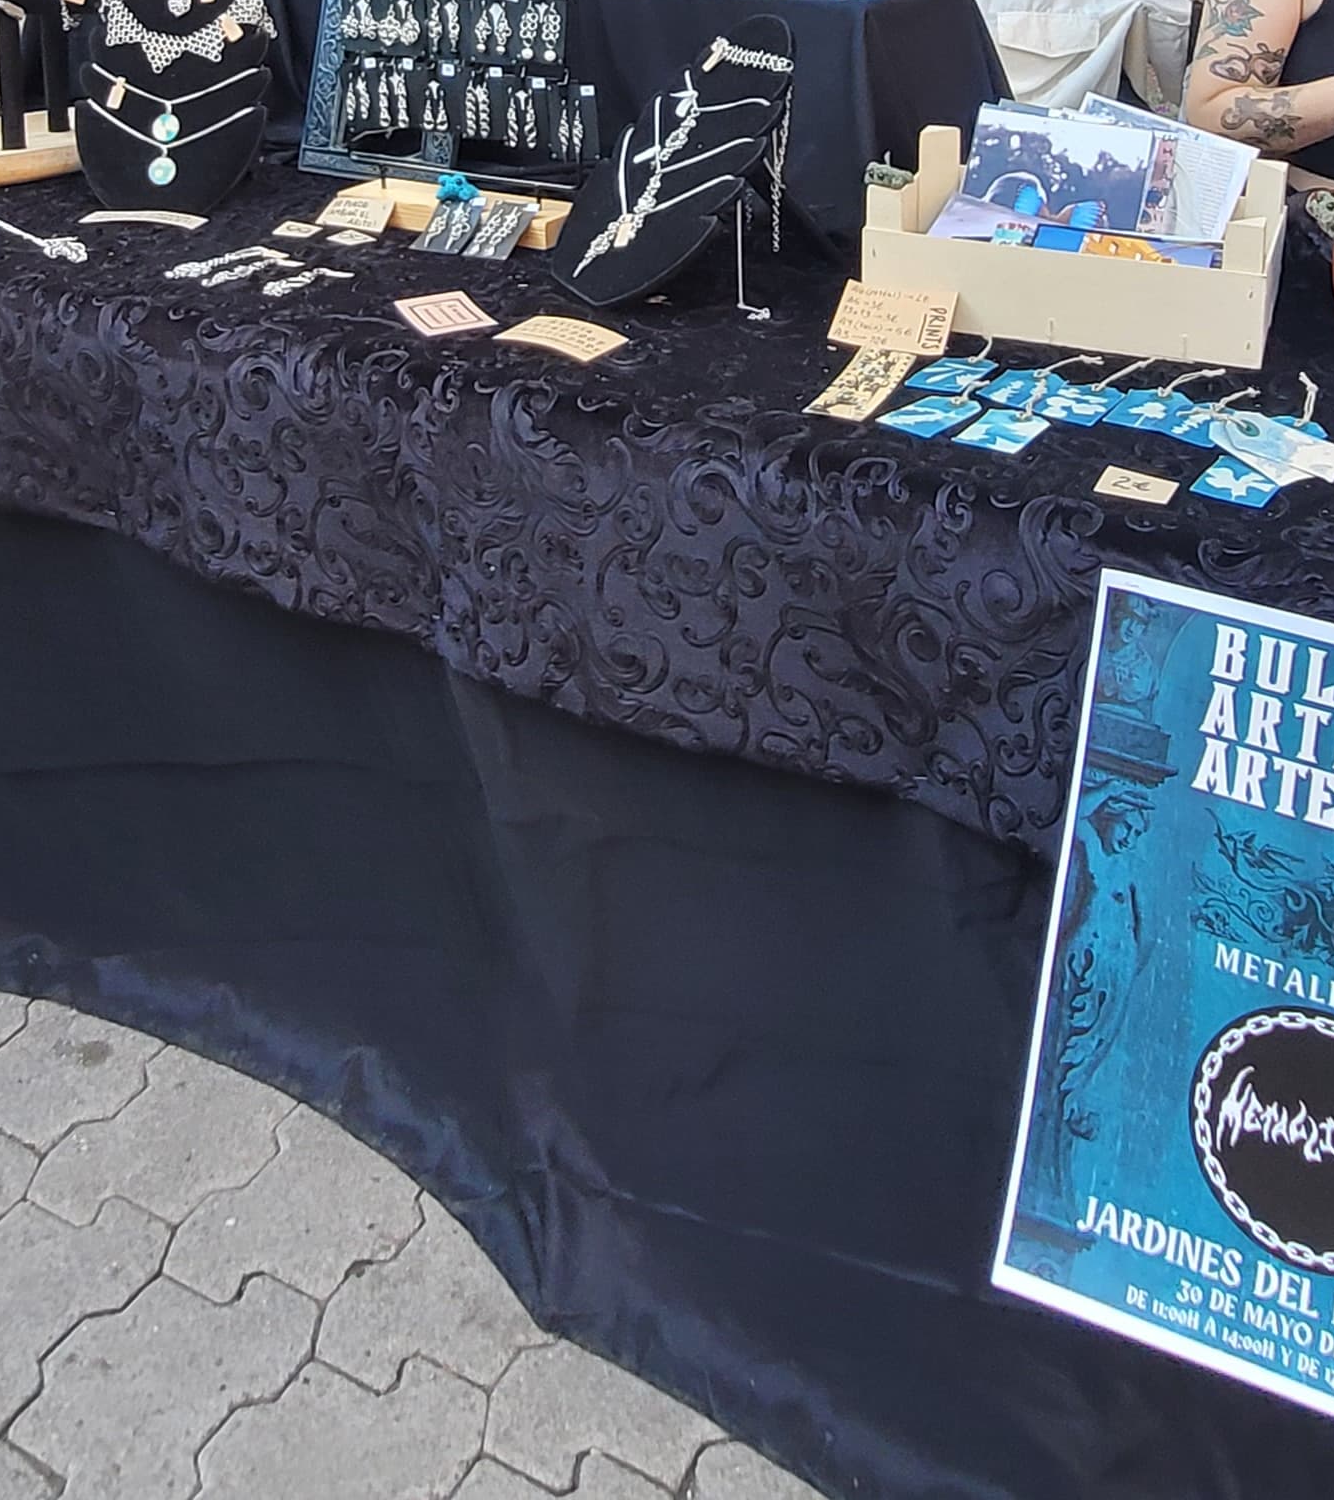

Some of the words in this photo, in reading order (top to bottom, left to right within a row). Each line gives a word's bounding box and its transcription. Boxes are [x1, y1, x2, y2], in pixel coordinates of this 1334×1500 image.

[921, 307, 948, 350] PRINTS
[1112, 476, 1151, 492] 2€
[1076, 1195, 1243, 1289] JARDINES
[1253, 1258, 1320, 1319] DEL
[1126, 1283, 1149, 1307] DE
[1204, 1314, 1218, 1338] A
[1279, 1343, 1294, 1367] Y
[1297, 1352, 1321, 1379] DE
[1176, 1279, 1203, 1304] 30
[1209, 1289, 1238, 1317] DE
[1242, 1301, 1314, 1346] MAYO
